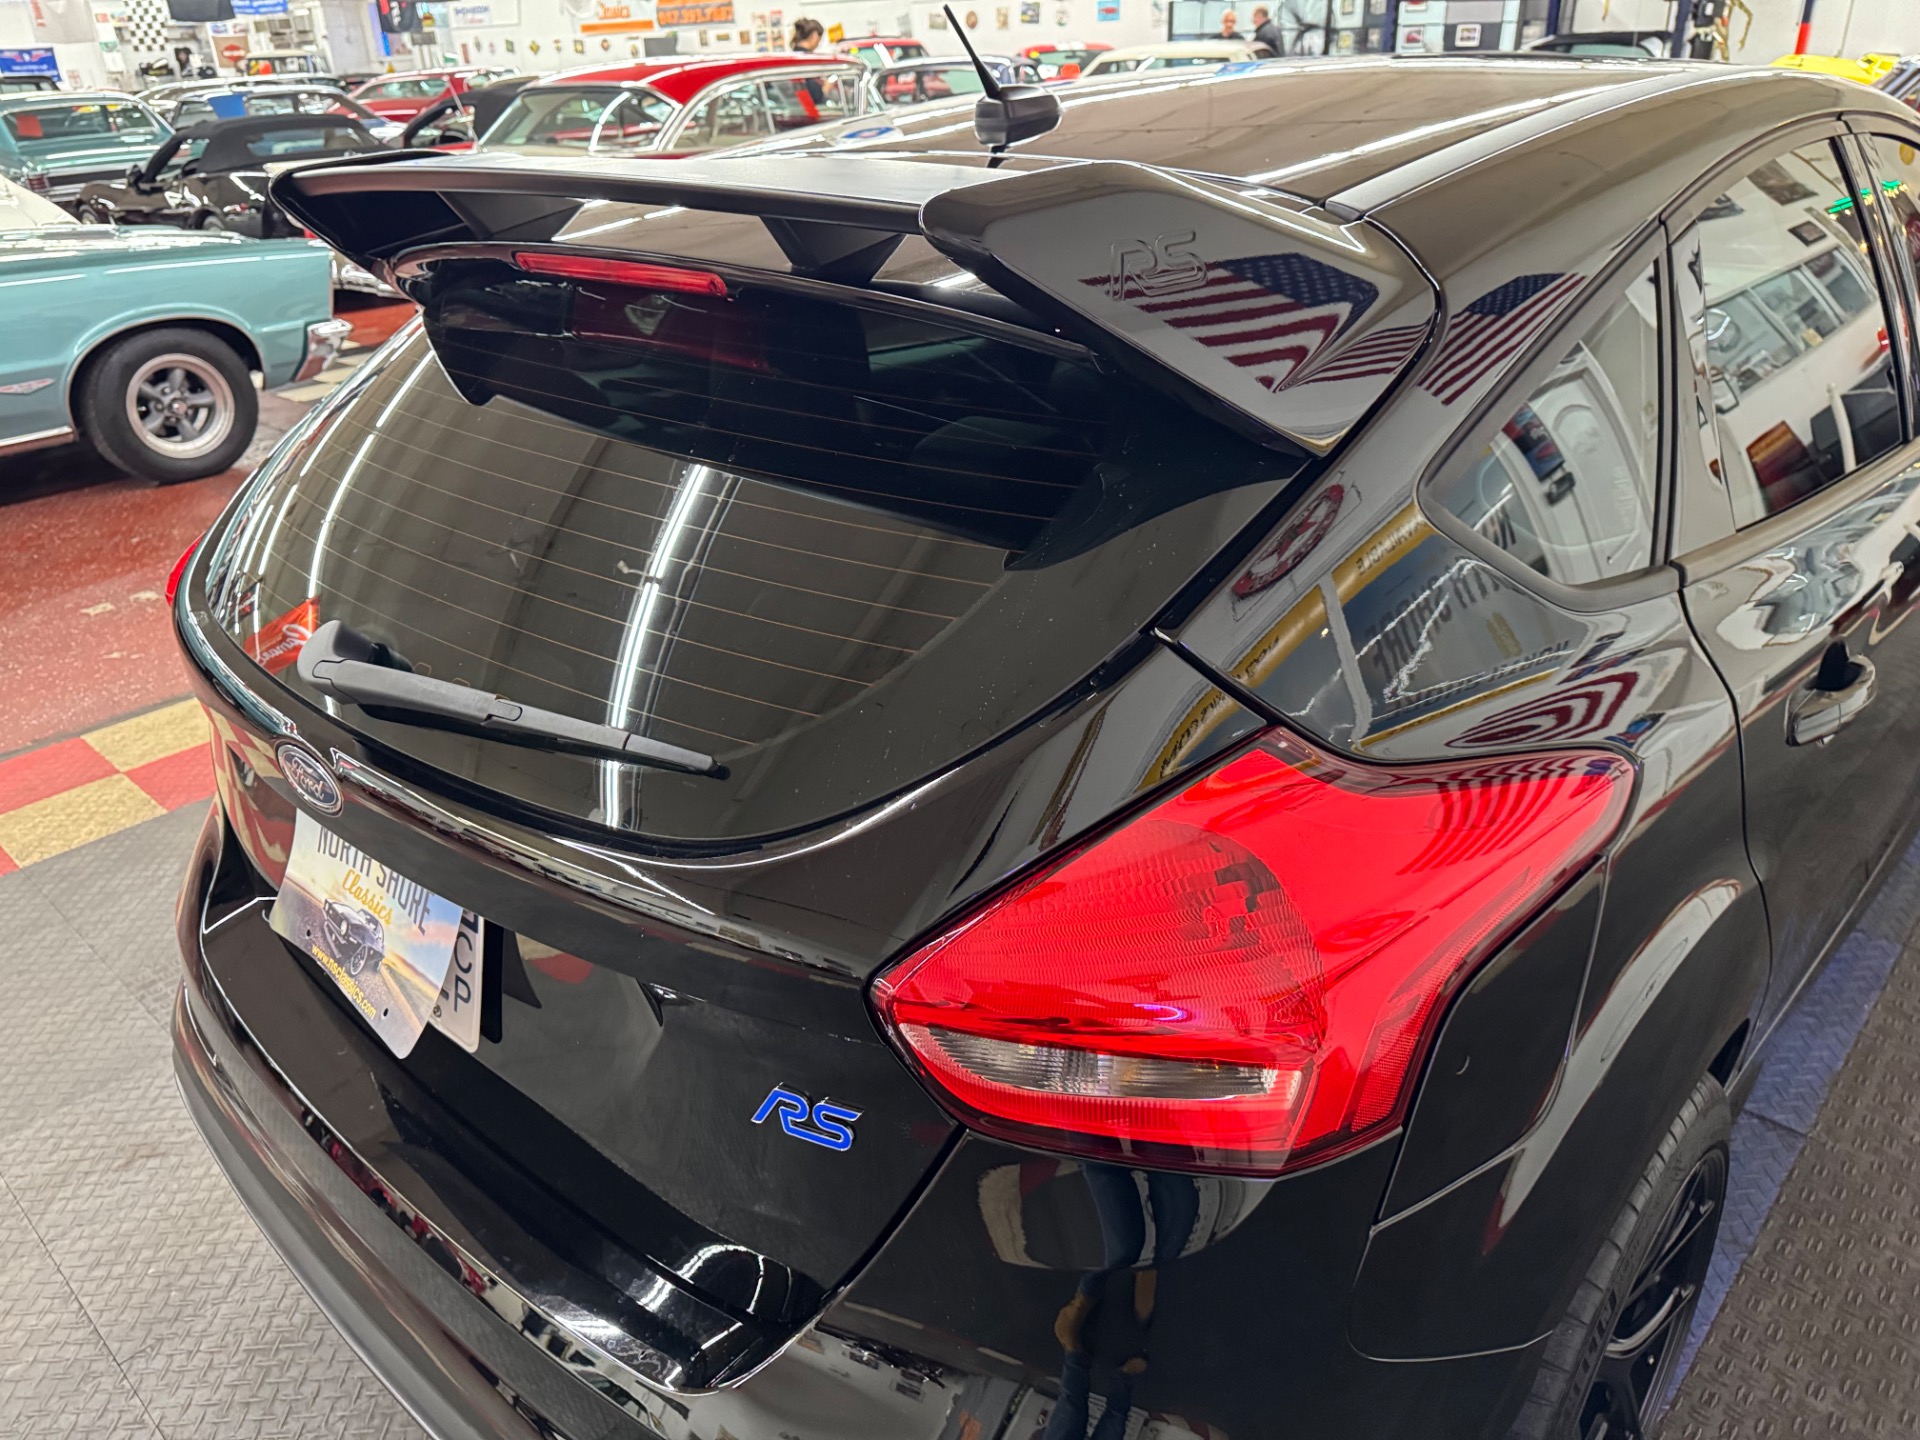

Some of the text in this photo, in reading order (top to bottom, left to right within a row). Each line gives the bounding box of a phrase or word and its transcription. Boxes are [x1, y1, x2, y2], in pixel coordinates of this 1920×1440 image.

[1109, 229, 1207, 301] RS
[291, 756, 325, 800] Ford
[342, 868, 393, 926] Classics
[311, 943, 377, 1020] www.nsclassics.com
[750, 1084, 864, 1152] RS
